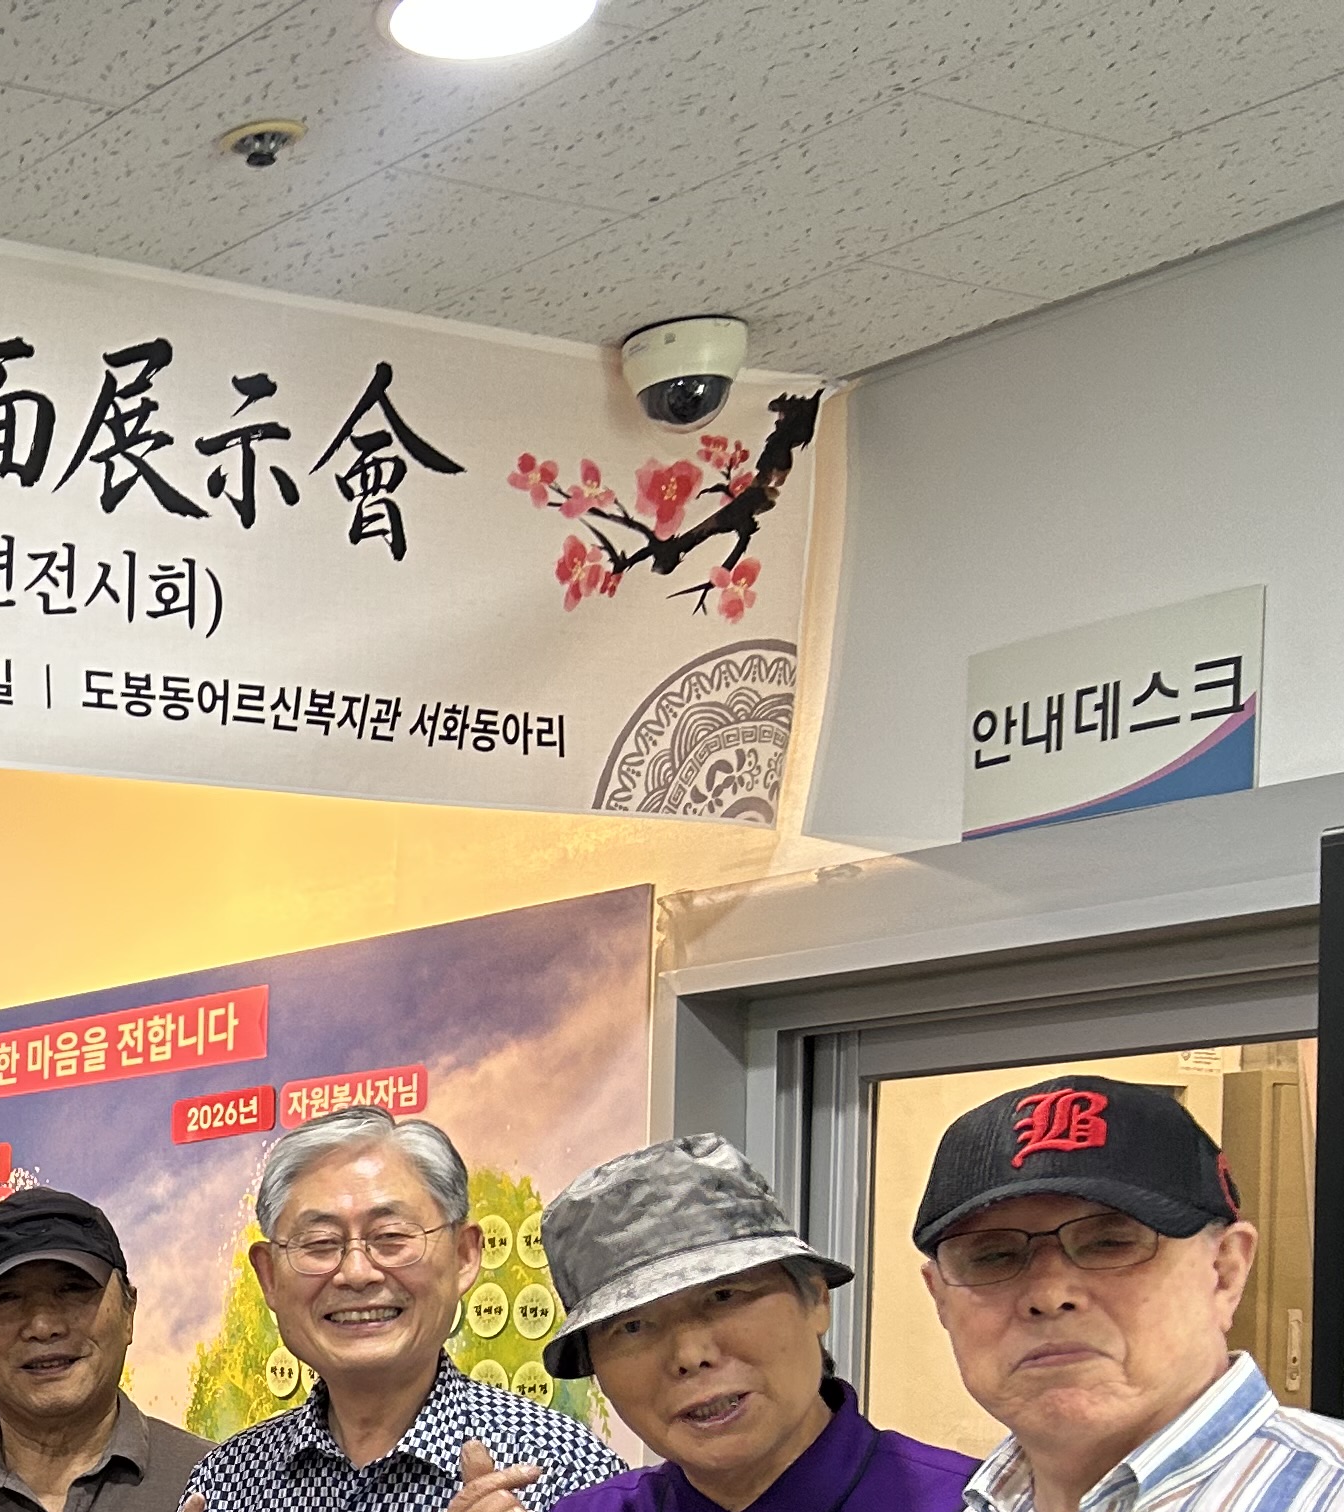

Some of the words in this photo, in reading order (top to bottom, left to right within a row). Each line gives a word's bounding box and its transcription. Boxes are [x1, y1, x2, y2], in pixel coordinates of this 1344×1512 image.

[83, 669, 402, 745] 도봉동어르신복지관
[409, 700, 565, 757] 서화동아리
[972, 656, 1246, 769] 안내데스크
[27, 1025, 109, 1080] 마음을
[118, 1001, 240, 1067] 전합니다
[187, 1096, 259, 1131] 2026년
[287, 1073, 419, 1120] 자원봉사자님
